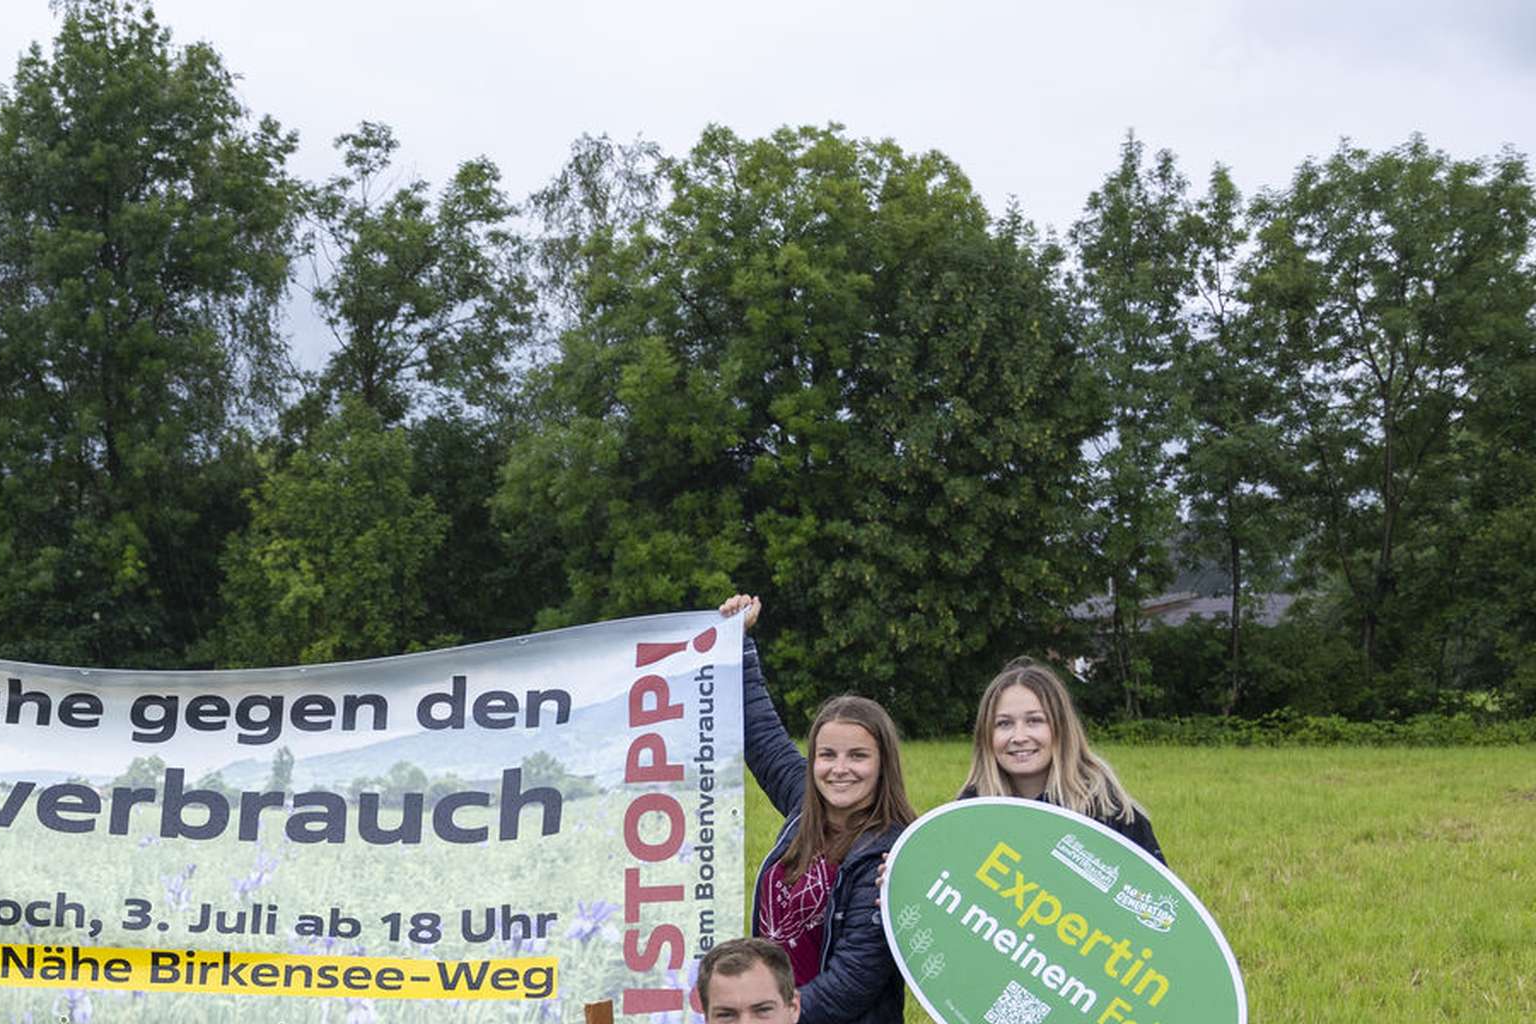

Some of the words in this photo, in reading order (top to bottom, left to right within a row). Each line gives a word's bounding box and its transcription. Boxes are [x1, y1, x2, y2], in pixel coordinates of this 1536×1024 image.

[130, 687, 389, 745] gegen
[416, 676, 572, 729] den
[694, 665, 714, 900] Bodenverbrauch
[123, 899, 169, 932] 3.
[189, 903, 277, 936] Juli
[296, 908, 362, 940] ab
[381, 912, 442, 945] 18
[462, 908, 557, 942] Uhr
[694, 909, 714, 959] em
[926, 871, 962, 914] in
[960, 907, 1098, 1014] meinem
[975, 841, 1171, 1007] Expertin
[1, 945, 132, 982] Nähe
[149, 950, 556, 999] Birkensee-Weg
